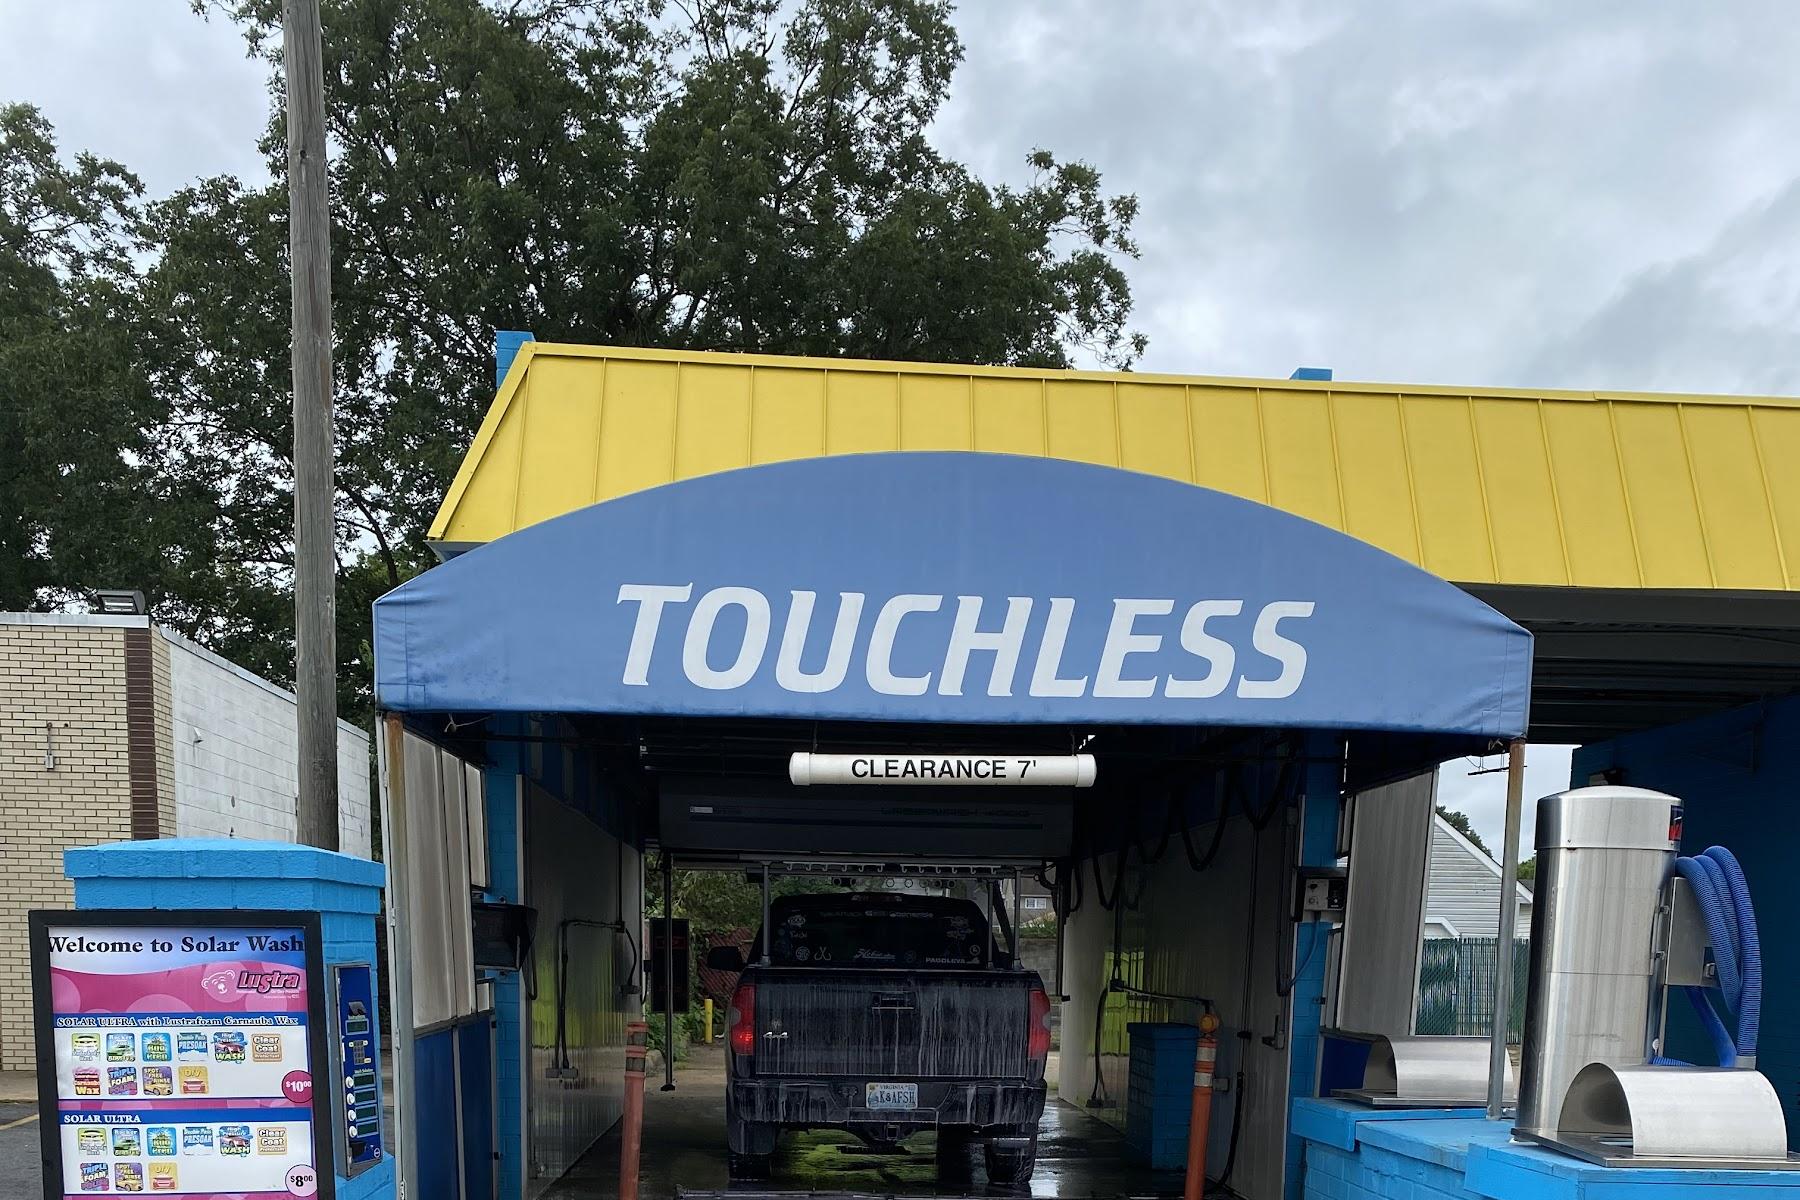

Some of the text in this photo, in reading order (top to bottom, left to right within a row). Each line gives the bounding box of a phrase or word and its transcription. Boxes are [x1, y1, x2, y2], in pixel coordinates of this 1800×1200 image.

[617, 582, 1315, 700] TOUCHLESS
[851, 759, 1036, 778] CLEARANCE 7'
[49, 935, 305, 953] Welcome to Solar Wash
[238, 970, 300, 993] Lustra
[57, 1016, 299, 1027] SOLAR ULTRA with Lustrafoam Carnauba Wax
[178, 1041, 207, 1049] PRESOAK
[254, 1036, 280, 1044] Clear
[109, 1067, 135, 1078] TRIPLE
[111, 1076, 134, 1086] FOAM
[76, 1086, 100, 1095] Wax
[63, 1114, 141, 1124] SOLAR ULTRA
[259, 1129, 285, 1138] Clear
[184, 1135, 213, 1144] PRESOAK
[261, 1138, 285, 1146] Coat
[221, 1146, 250, 1154] WASH
[83, 1163, 107, 1174] TRIPLE
[84, 1171, 106, 1181] FOAM
